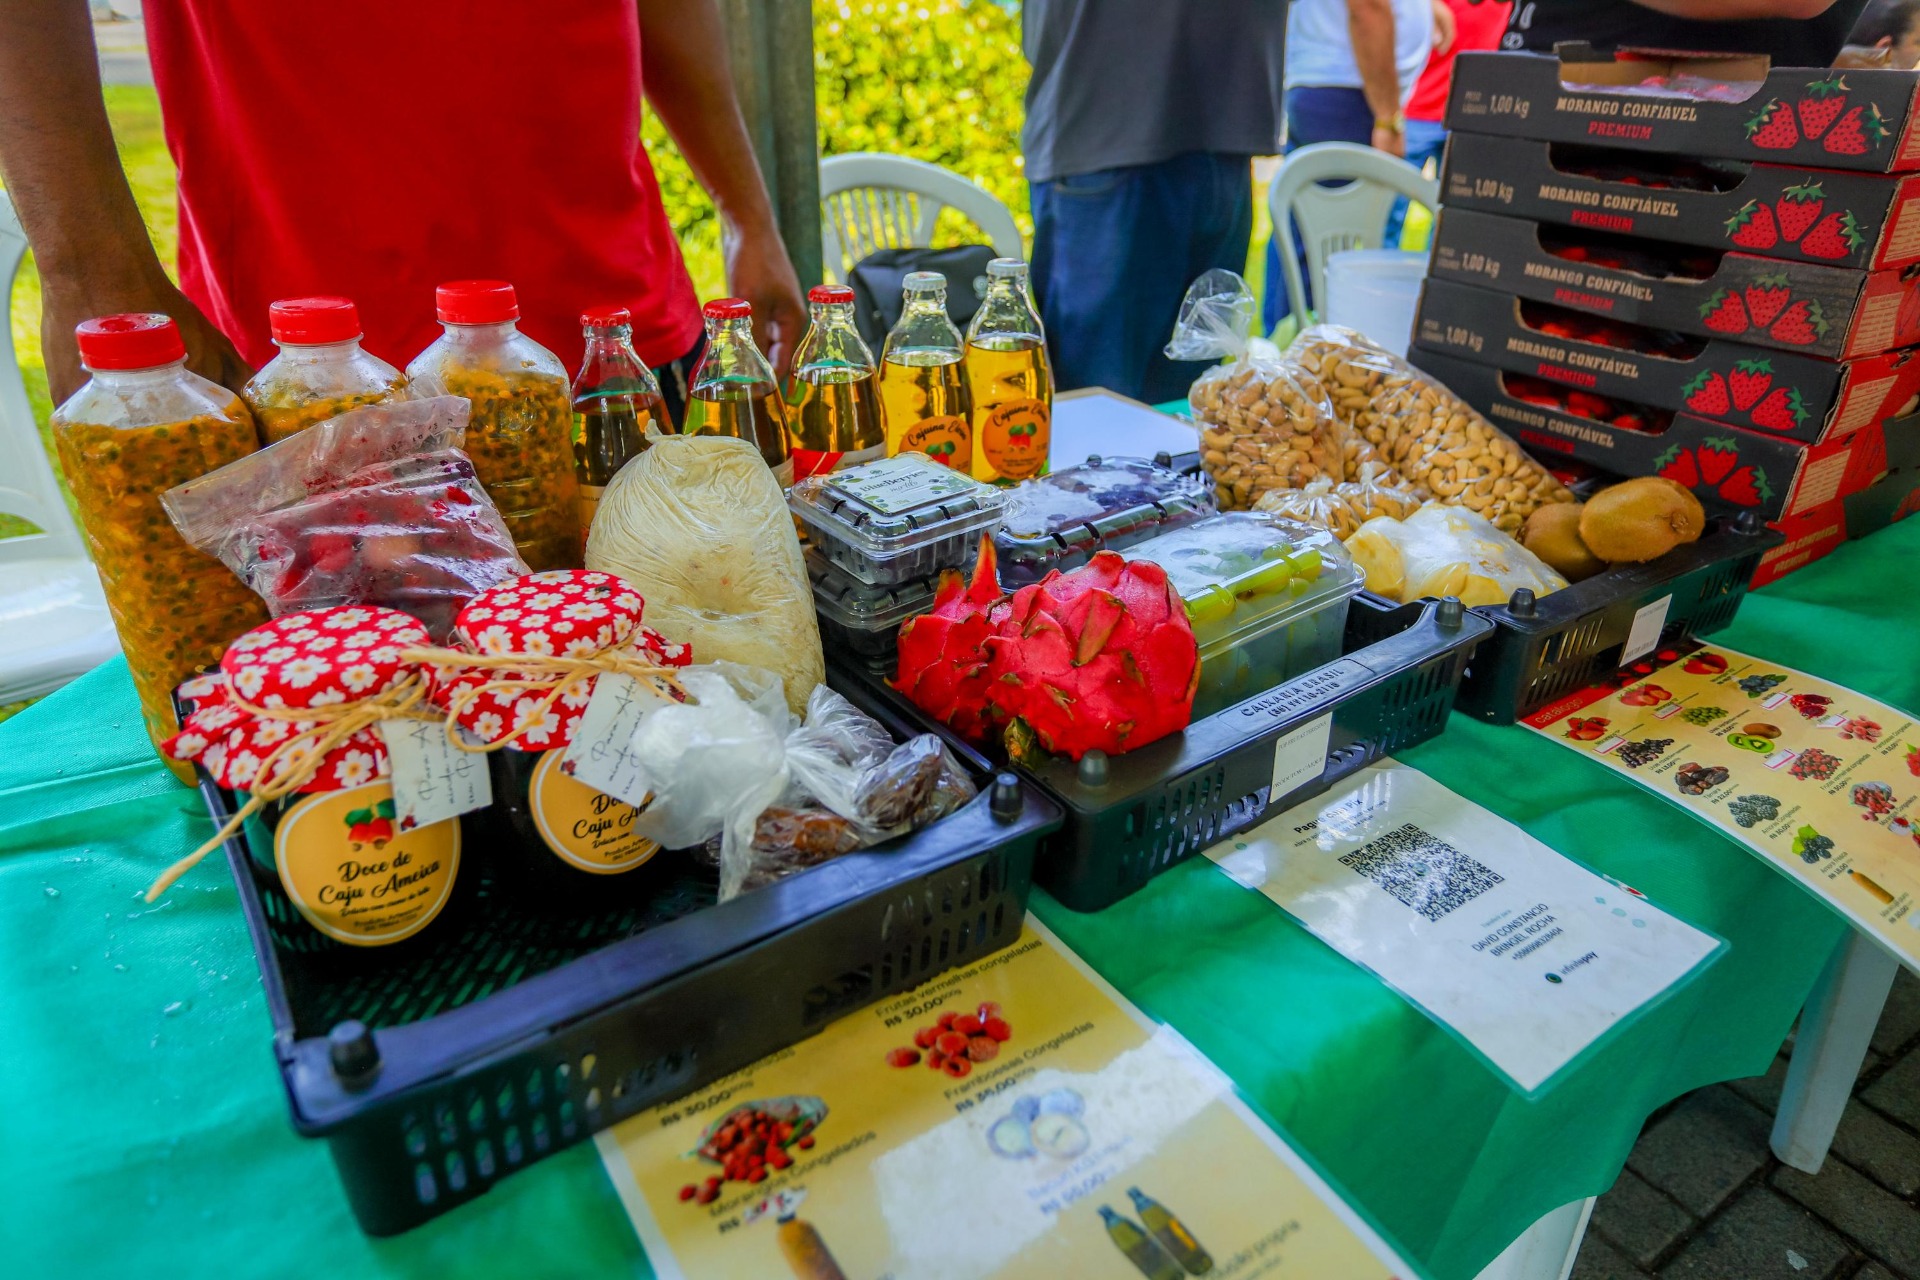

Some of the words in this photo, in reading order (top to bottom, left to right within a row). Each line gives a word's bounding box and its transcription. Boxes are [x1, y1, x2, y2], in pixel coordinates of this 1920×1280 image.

[1490, 94, 1512, 115] 1,00
[1514, 96, 1529, 118] kg
[1556, 97, 1618, 115] MORANGO
[1622, 101, 1697, 122] CONFIÁVEL
[1588, 121, 1653, 140] PREMIUM
[1474, 178, 1497, 198] 1,00
[1498, 182, 1514, 204] kg
[1539, 185, 1600, 206] MORANGO
[1602, 195, 1678, 217] CONFIÁVEL
[1570, 209, 1634, 232] PREMIUM
[1461, 252, 1484, 271] 1,00
[1484, 256, 1500, 279] kg
[1524, 262, 1584, 285] MORANGO
[1586, 274, 1653, 301] CONFIÁVEL
[1554, 288, 1615, 311] PREMIUM
[1468, 330, 1483, 352] kg
[1507, 337, 1565, 362] MORANGO
[1568, 350, 1639, 379] CONFIÁVEL
[1537, 363, 1597, 388] PREMIUM
[1490, 403, 1546, 428] MORANGO
[1547, 418, 1614, 449] CONFIÁVEL
[1240, 686, 1305, 717] CAIXARIA
[1301, 668, 1344, 690] BRASIL
[573, 818, 613, 838] Caju
[1293, 817, 1325, 834] Pague
[338, 860, 389, 883] Doce
[392, 851, 412, 869] de
[318, 884, 365, 907] Caju
[371, 860, 441, 899] Ameixa
[1472, 933, 1500, 952] DAVID
[1497, 903, 1549, 937] CONSTANCIO
[1490, 933, 1530, 957] BRINGEL
[1524, 914, 1557, 936] ROCHA
[875, 994, 917, 1018] Frutas
[918, 967, 979, 998] vermelhas
[978, 937, 1043, 972] congeladas
[883, 1013, 902, 1029] R$
[905, 997, 944, 1019] 30,00
[943, 1057, 1024, 1100] Framboesas
[1023, 1020, 1095, 1060] Congeladas
[660, 1114, 681, 1128] R$
[685, 1090, 731, 1116] 30,00
[954, 1098, 974, 1114] R$
[709, 1174, 788, 1218] Morangos
[789, 1130, 878, 1175] Congelados
[718, 1218, 741, 1234] R$
